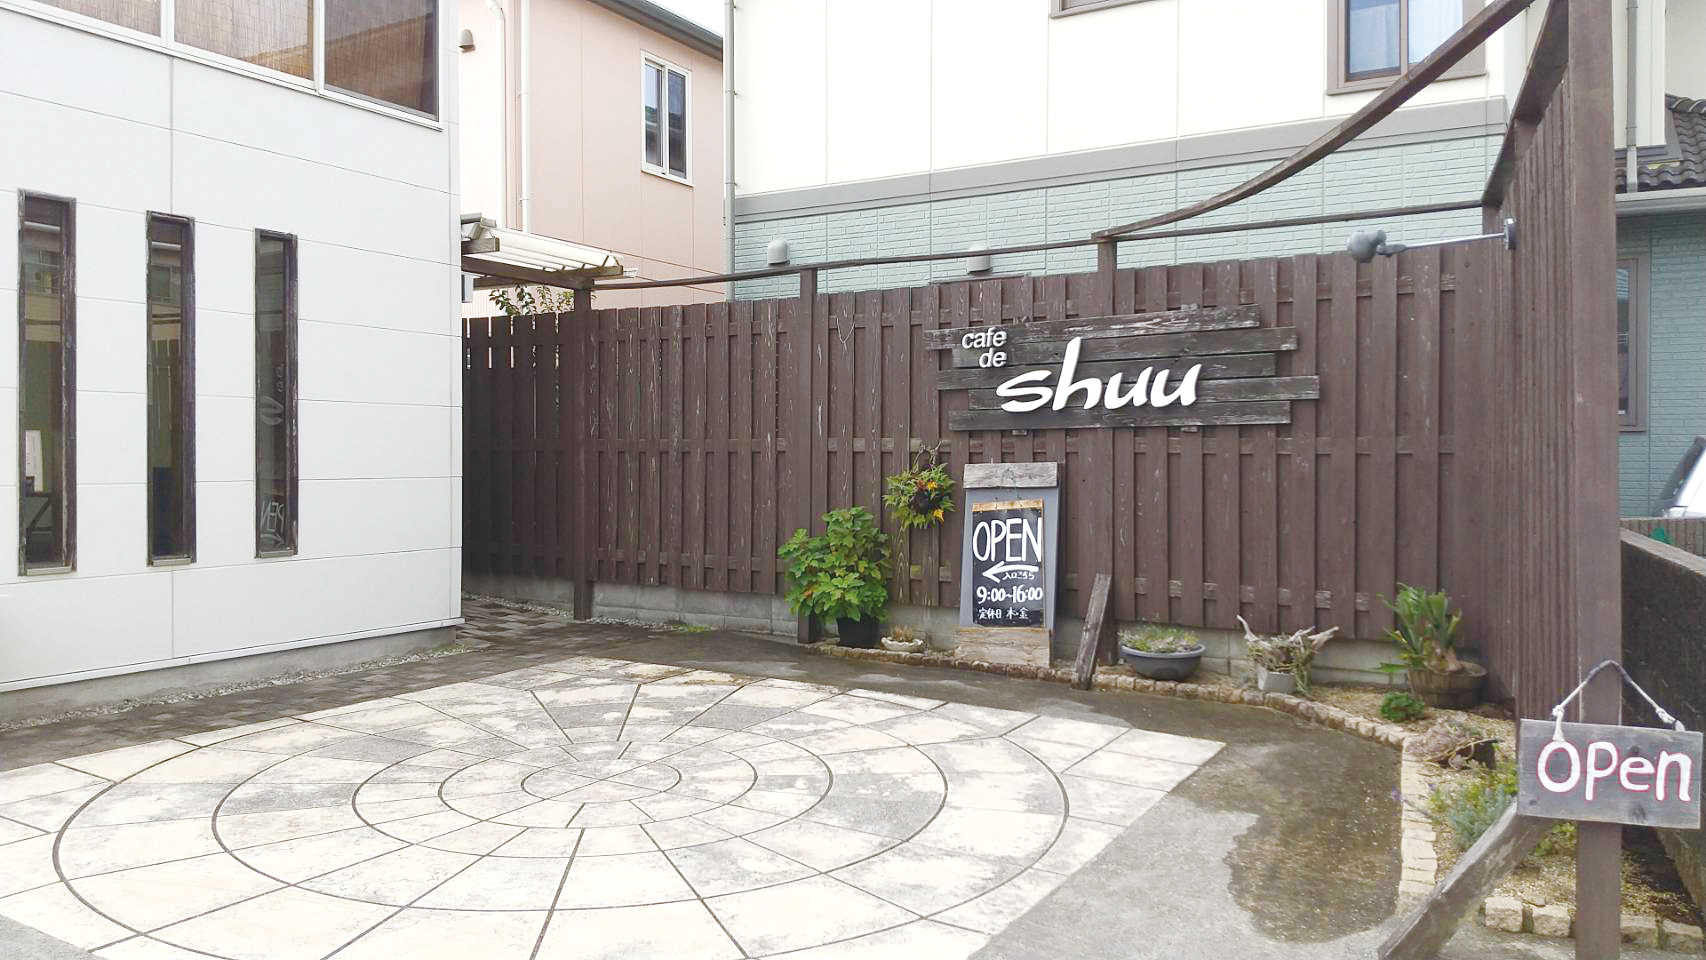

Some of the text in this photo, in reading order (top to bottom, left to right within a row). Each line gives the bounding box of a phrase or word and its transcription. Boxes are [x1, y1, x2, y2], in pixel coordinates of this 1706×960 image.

[961, 327, 1007, 348] cafe
[978, 348, 1007, 369] de
[995, 336, 1202, 413] shuu
[973, 517, 1042, 563] OPEN
[977, 607, 1002, 620] 定休日
